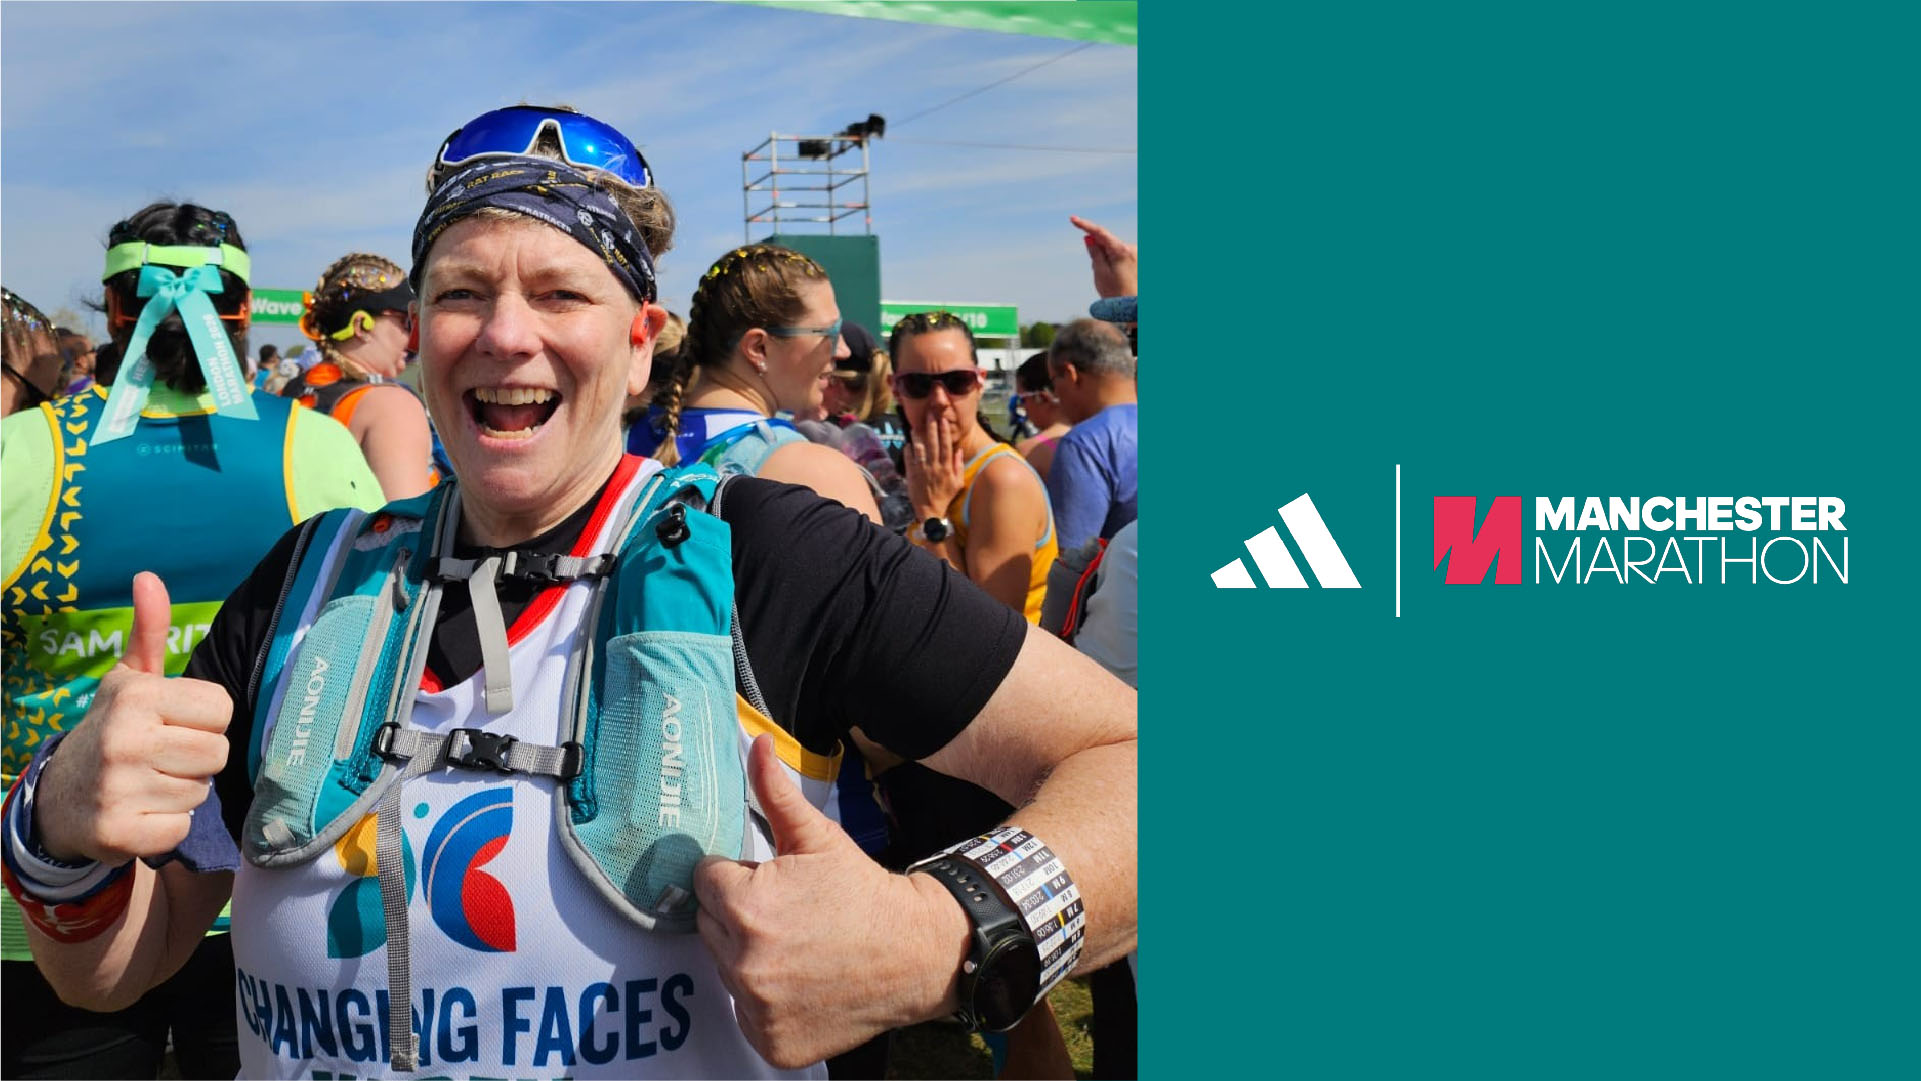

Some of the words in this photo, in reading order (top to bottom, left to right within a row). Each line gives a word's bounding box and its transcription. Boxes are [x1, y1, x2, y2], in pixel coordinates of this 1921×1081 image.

[251, 297, 303, 315] Wave
[207, 356, 233, 407] LONDON
[213, 340, 245, 404] MARATHON
[40, 623, 211, 658] SAMRIT
[286, 656, 329, 766] AONIJIE
[660, 691, 683, 829] AONIJIE
[502, 973, 695, 1067] FACES
